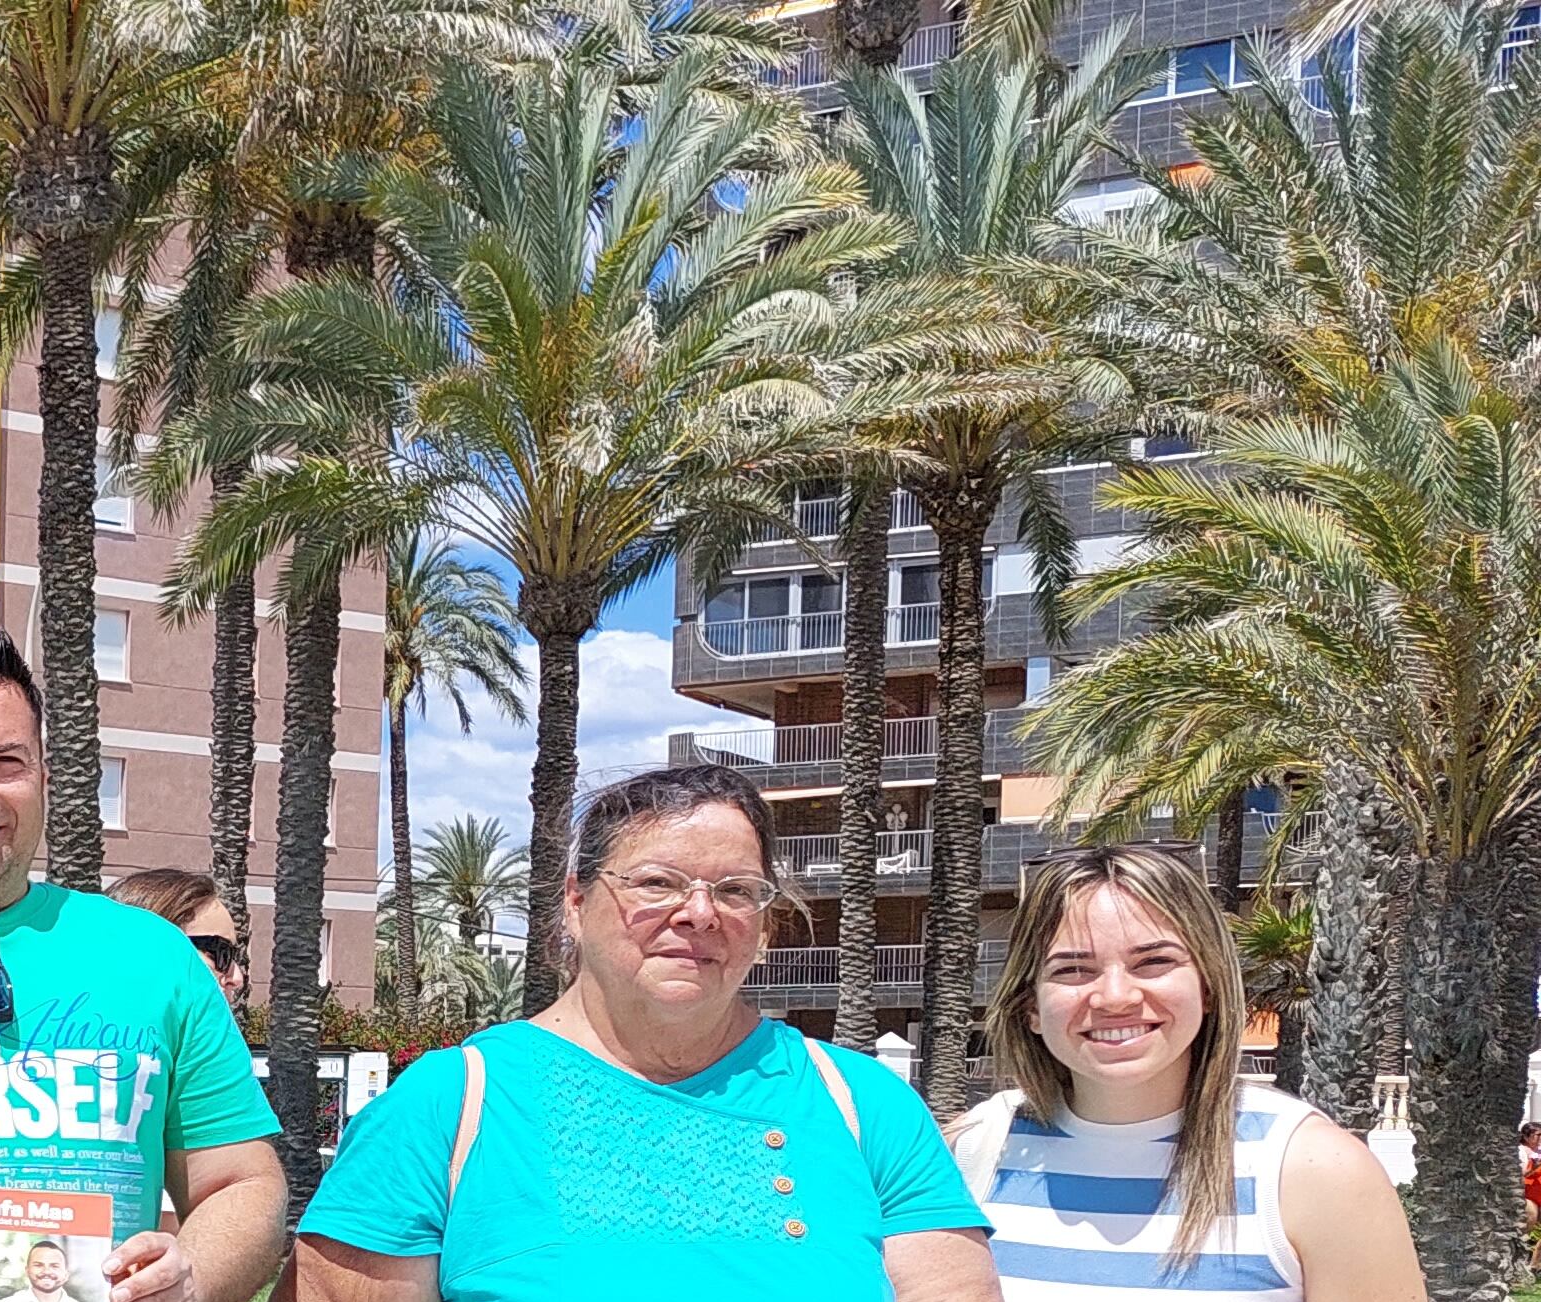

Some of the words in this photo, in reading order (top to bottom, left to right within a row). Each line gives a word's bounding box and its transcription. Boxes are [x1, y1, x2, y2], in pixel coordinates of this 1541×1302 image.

[13, 1147, 28, 1158] as
[30, 1144, 58, 1158] well
[61, 1148, 75, 1159] as
[77, 1149, 104, 1160] over
[4, 1176, 44, 1189] brave
[46, 1178, 81, 1191] stand
[84, 1178, 103, 1192] the
[28, 1201, 74, 1221] Mas
